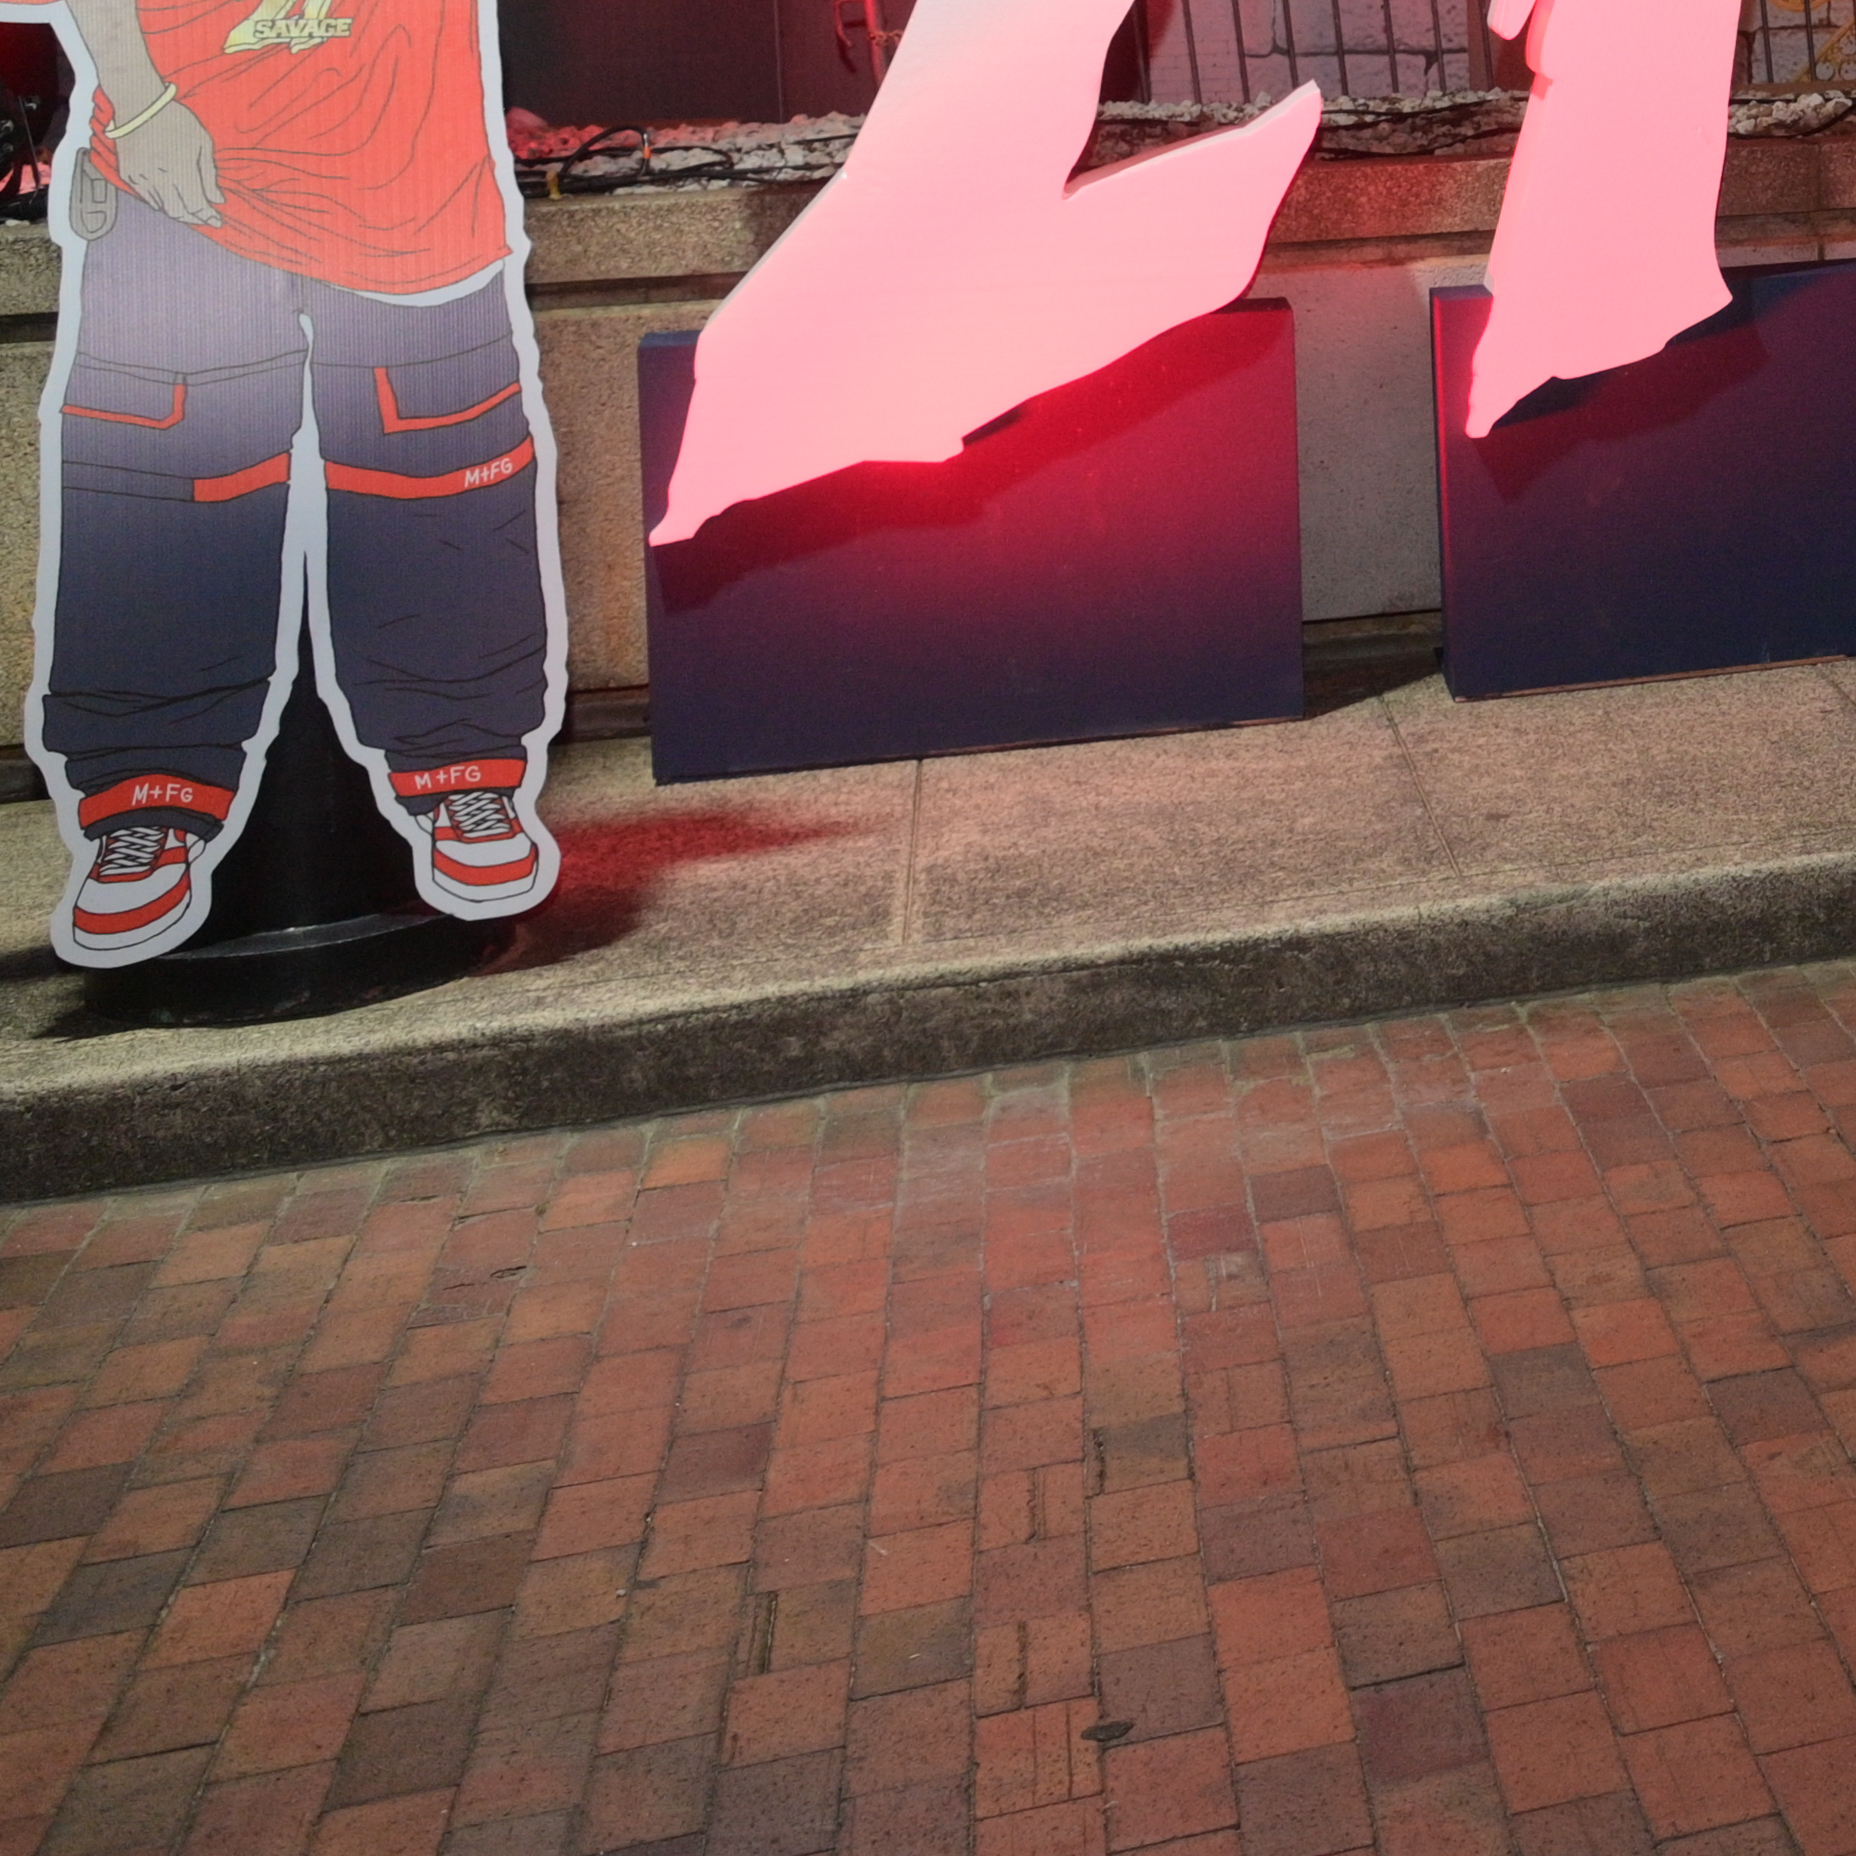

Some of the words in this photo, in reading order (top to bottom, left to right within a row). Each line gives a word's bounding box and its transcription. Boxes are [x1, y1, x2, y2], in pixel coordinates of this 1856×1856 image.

[254, 18, 353, 39] SAVAGE
[464, 457, 514, 489] M+FG
[414, 765, 482, 790] M+FG
[131, 783, 195, 807] M+FG
